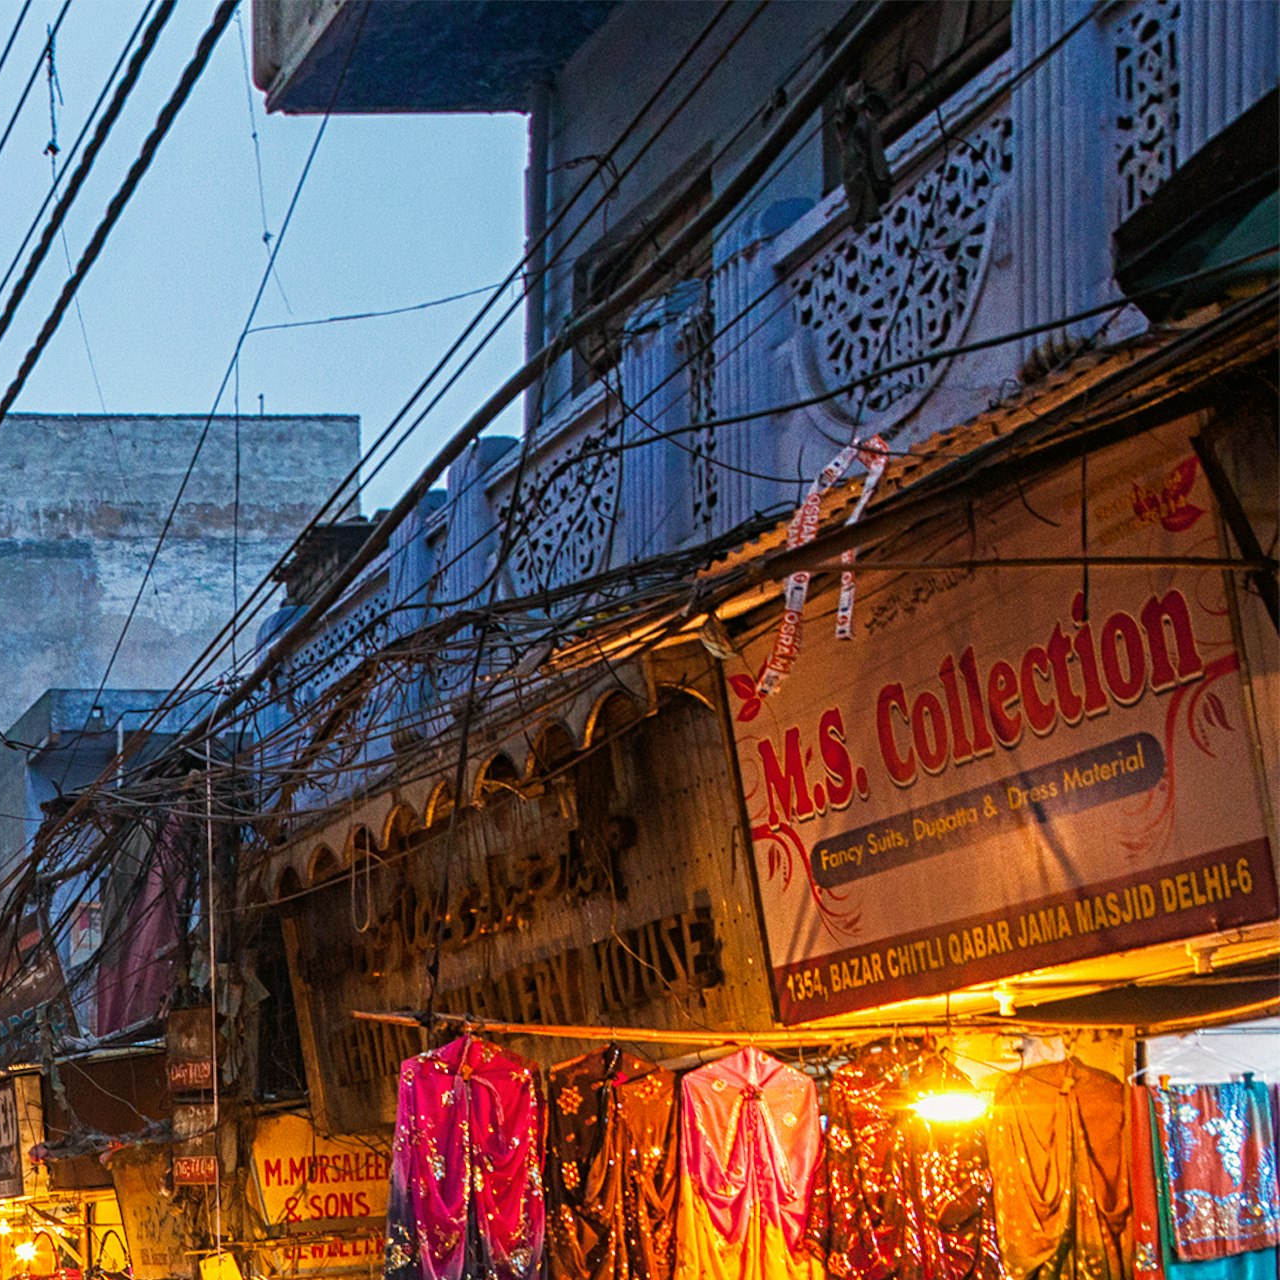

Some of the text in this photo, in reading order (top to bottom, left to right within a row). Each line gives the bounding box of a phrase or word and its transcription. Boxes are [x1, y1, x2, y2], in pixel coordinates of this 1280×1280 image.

[771, 611, 799, 671] OSRAM
[756, 706, 870, 831] M.S.
[876, 588, 1205, 788] Collection
[820, 742, 1146, 872] Fancy Suits, Dupatta & Dress Material
[786, 857, 1254, 1002] 1354, BAZAR CHITLI QABAR JAMA MASJID DELHI-6
[285, 1191, 371, 1223] & SONS
